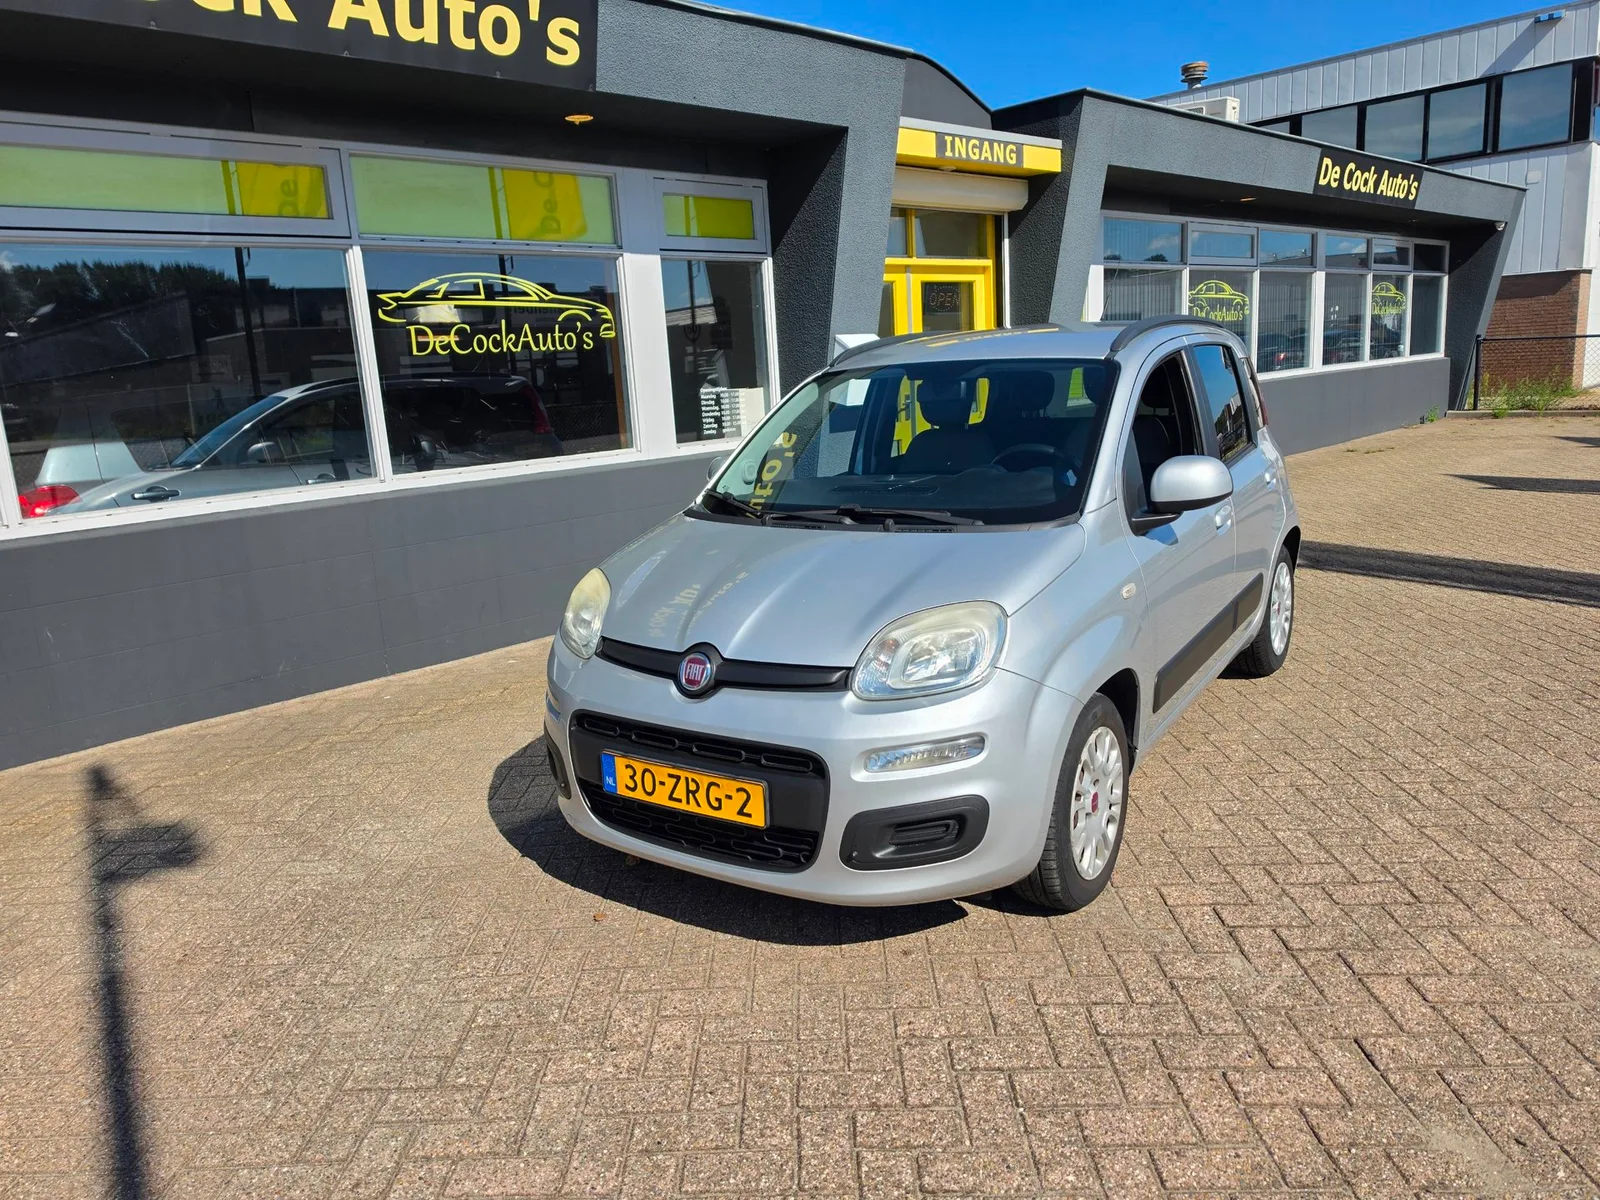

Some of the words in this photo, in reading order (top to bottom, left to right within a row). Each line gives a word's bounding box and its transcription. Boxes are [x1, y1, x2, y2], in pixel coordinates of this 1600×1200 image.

[327, 0, 580, 66] Auto's
[944, 135, 1017, 165] INGANG
[1318, 156, 1341, 188] De
[1343, 161, 1378, 194] Cock
[1376, 169, 1419, 201] Auto's
[929, 292, 960, 306] OPEN
[406, 318, 594, 356] DeCockAuto's
[685, 663, 705, 681] FIAT
[605, 776, 616, 787] NL
[625, 764, 752, 818] 30-ZRG-2
